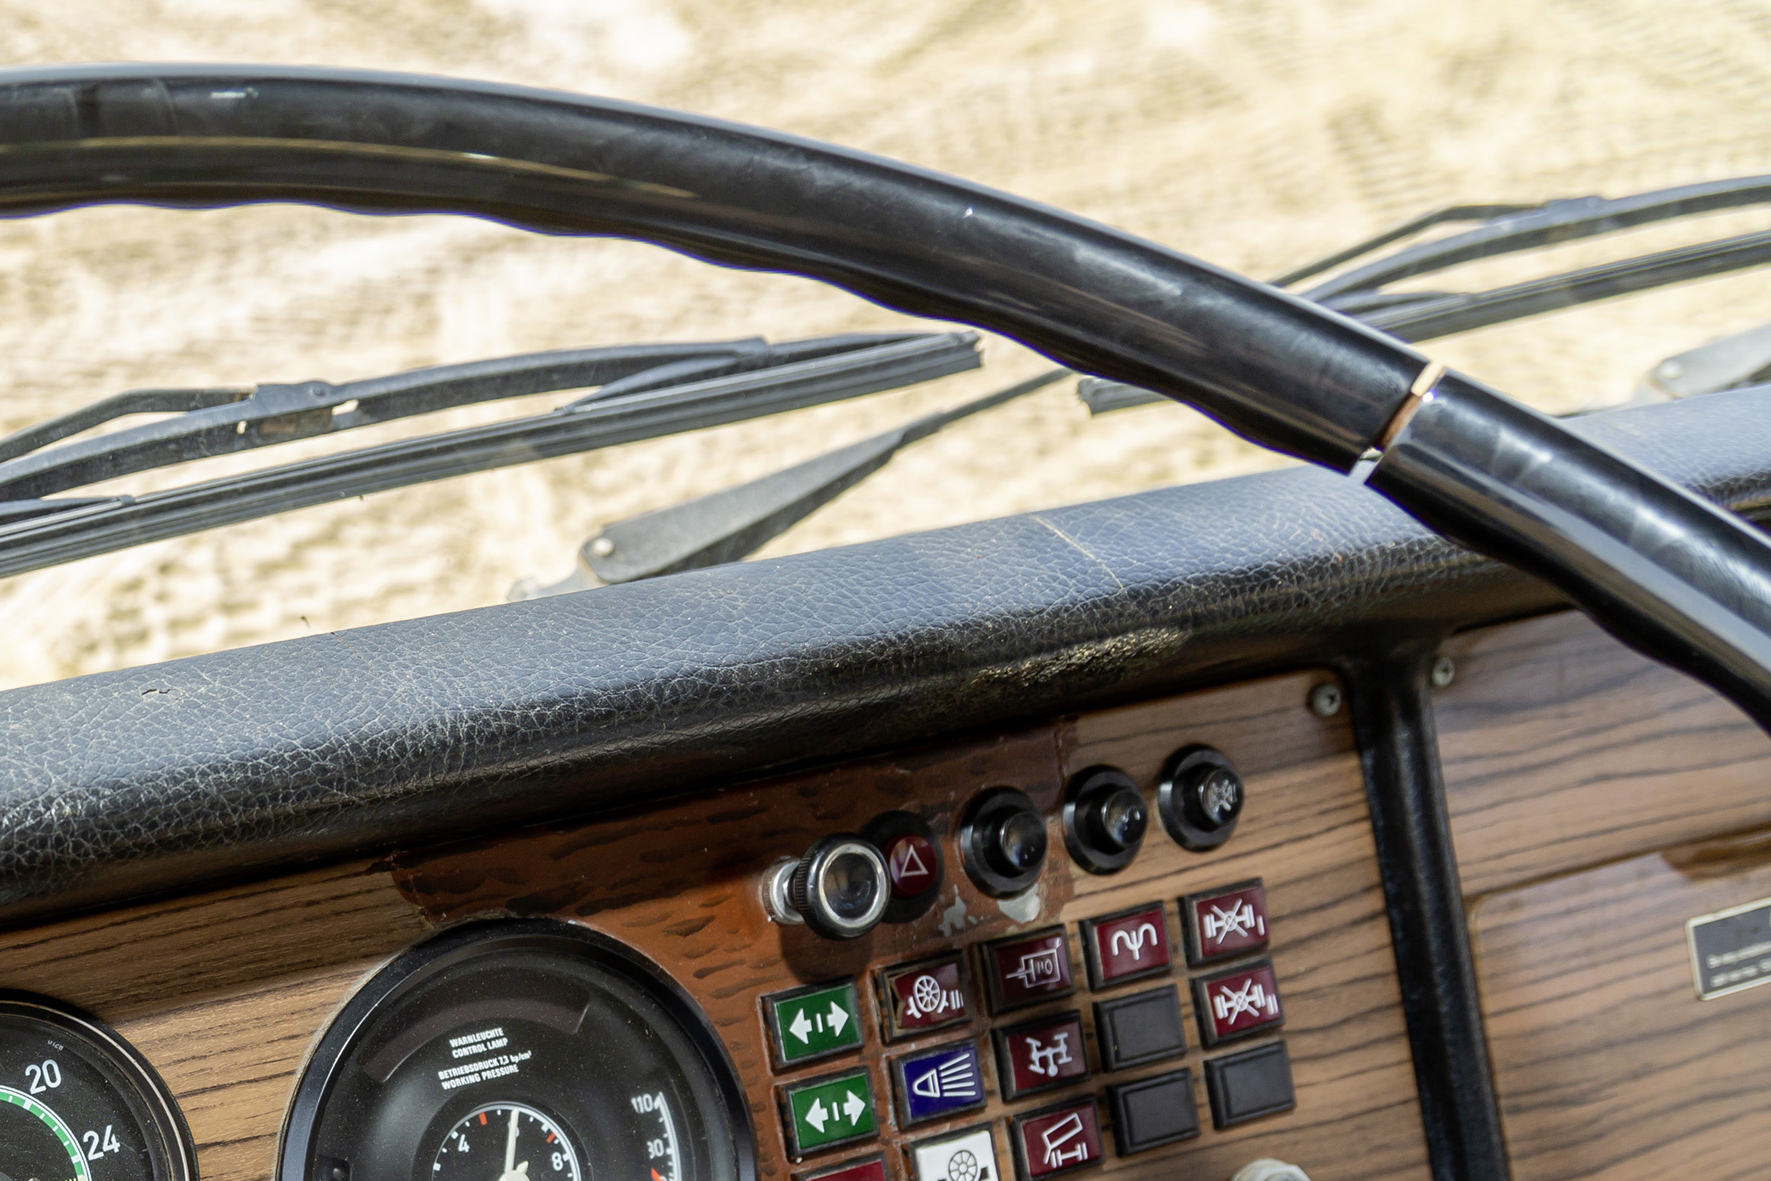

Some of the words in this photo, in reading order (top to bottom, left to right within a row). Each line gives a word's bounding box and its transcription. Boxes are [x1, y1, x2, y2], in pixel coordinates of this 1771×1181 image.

[449, 1027, 505, 1048] WARNLEUCHTE
[452, 1043, 487, 1059] CONTROL
[487, 1037, 509, 1050] LAMP
[25, 1059, 62, 1095] 20
[438, 1057, 499, 1080] BETRIEBSDRUCK
[441, 1073, 481, 1090] WORKING
[481, 1063, 520, 1081] PRESSURE
[83, 1125, 121, 1161] 24
[458, 1134, 470, 1153] 4
[551, 1152, 564, 1171] 8
